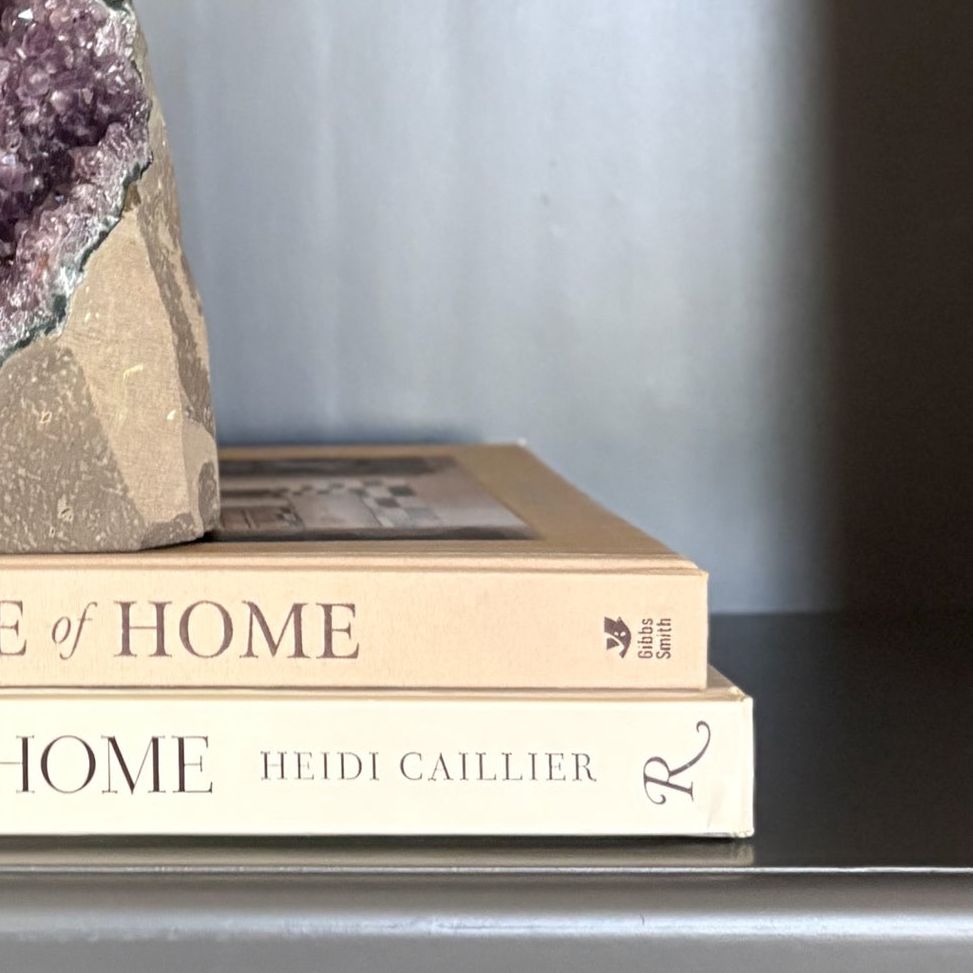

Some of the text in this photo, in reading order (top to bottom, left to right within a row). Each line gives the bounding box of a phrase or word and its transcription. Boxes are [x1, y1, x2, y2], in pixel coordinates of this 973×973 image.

[51, 601, 98, 660] of
[114, 600, 360, 659] HOME
[636, 617, 654, 660] Gibbs
[655, 617, 673, 660] Smith
[260, 751, 598, 783] HEIDI CAILLIER
[642, 719, 712, 806] R
